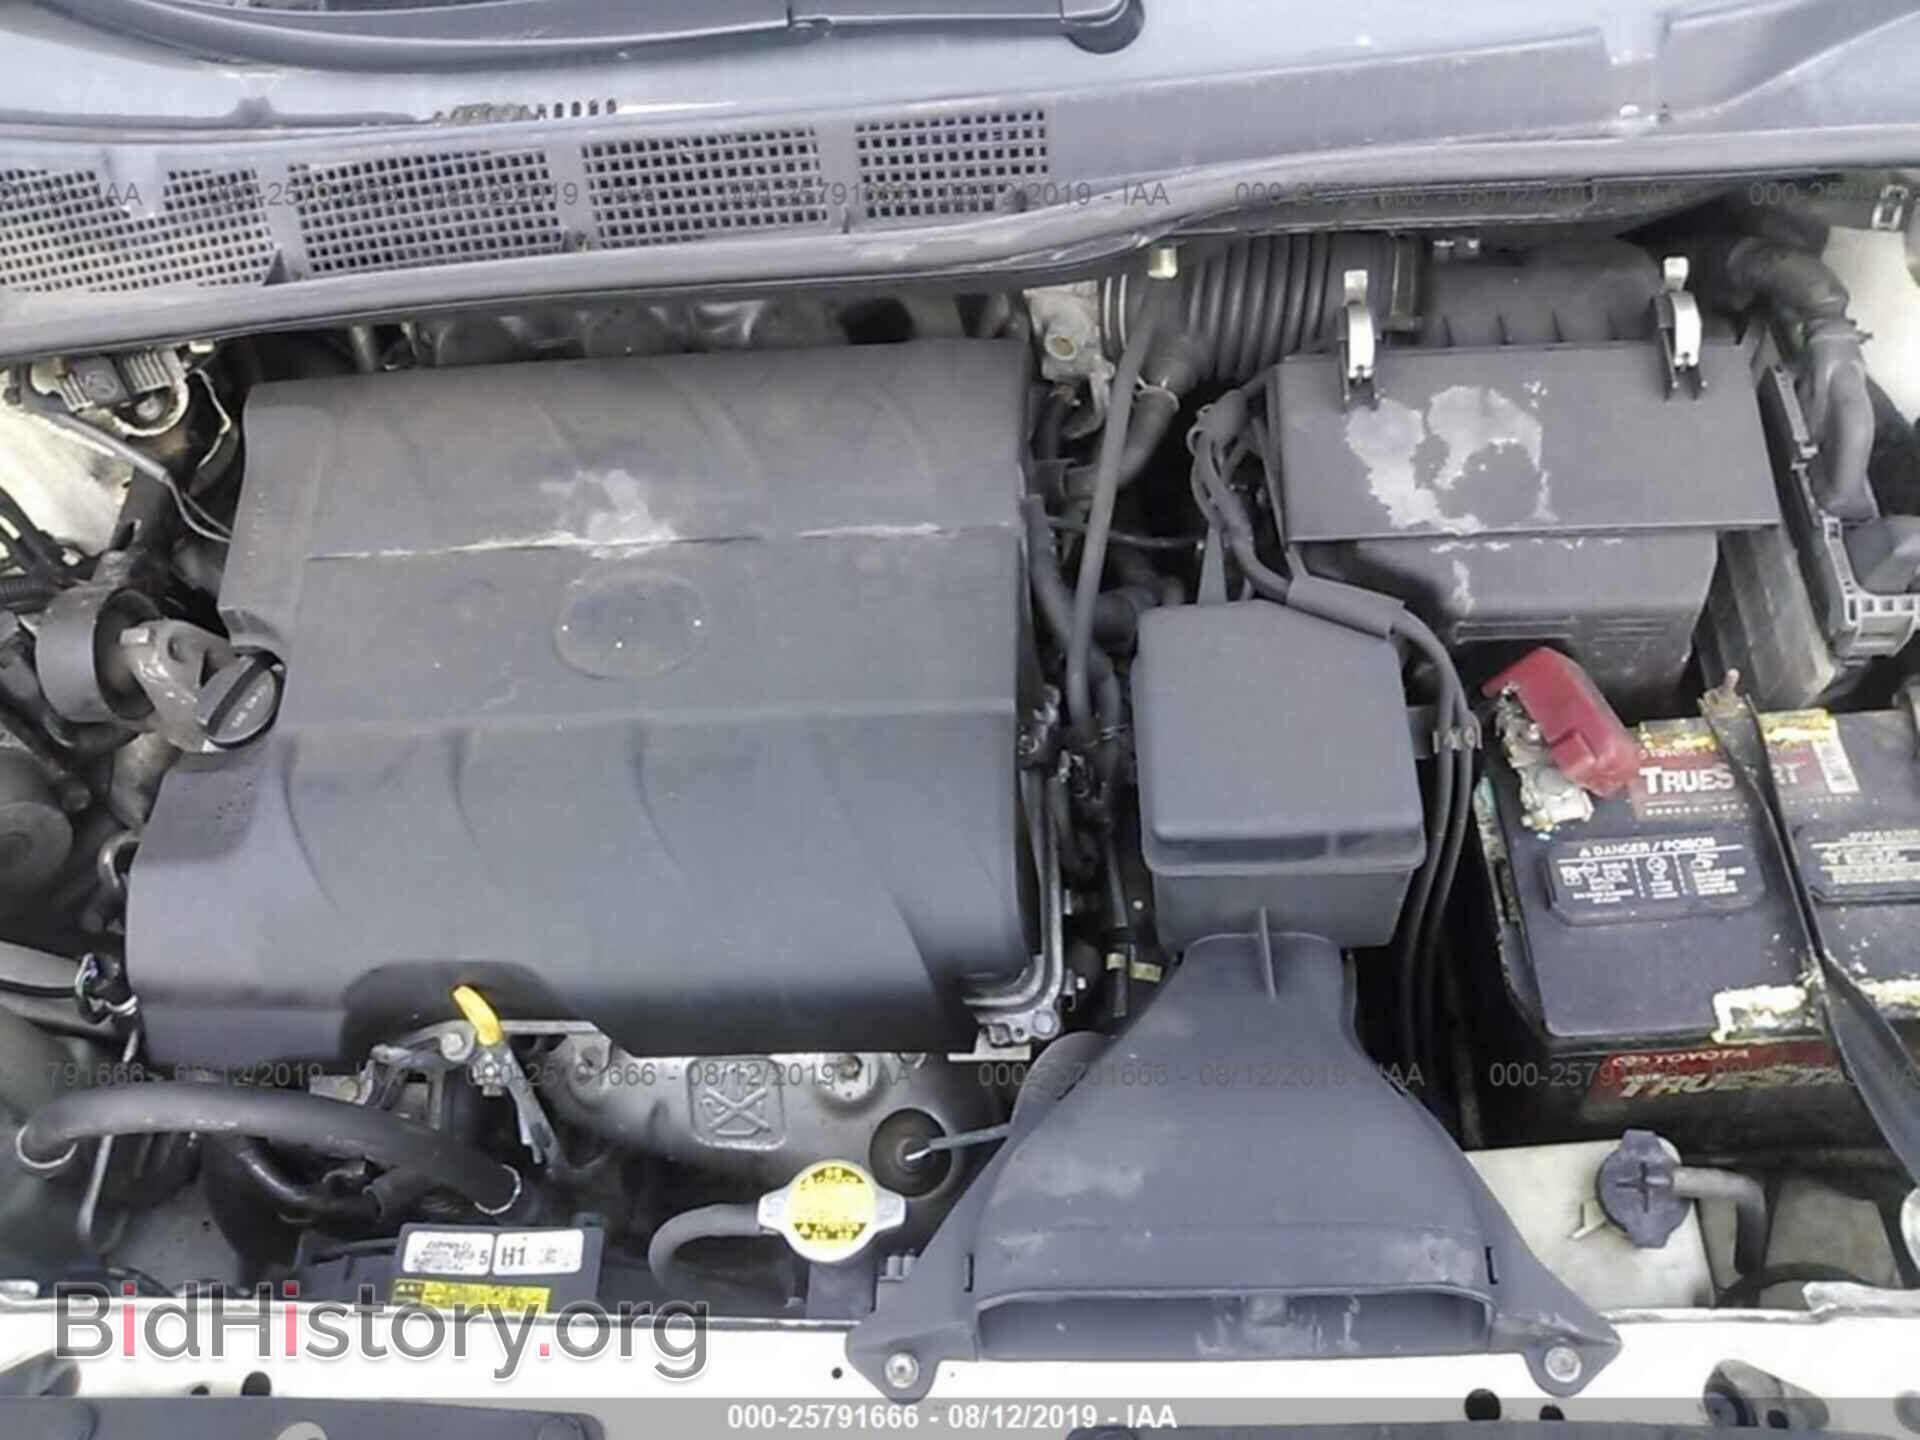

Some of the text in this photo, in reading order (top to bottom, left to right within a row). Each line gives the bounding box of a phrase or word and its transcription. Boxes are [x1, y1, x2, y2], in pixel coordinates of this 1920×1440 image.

[1638, 761, 1803, 795] TRUESRT
[1652, 1048, 1752, 1066] TOYOTA
[500, 1246, 527, 1267] H1
